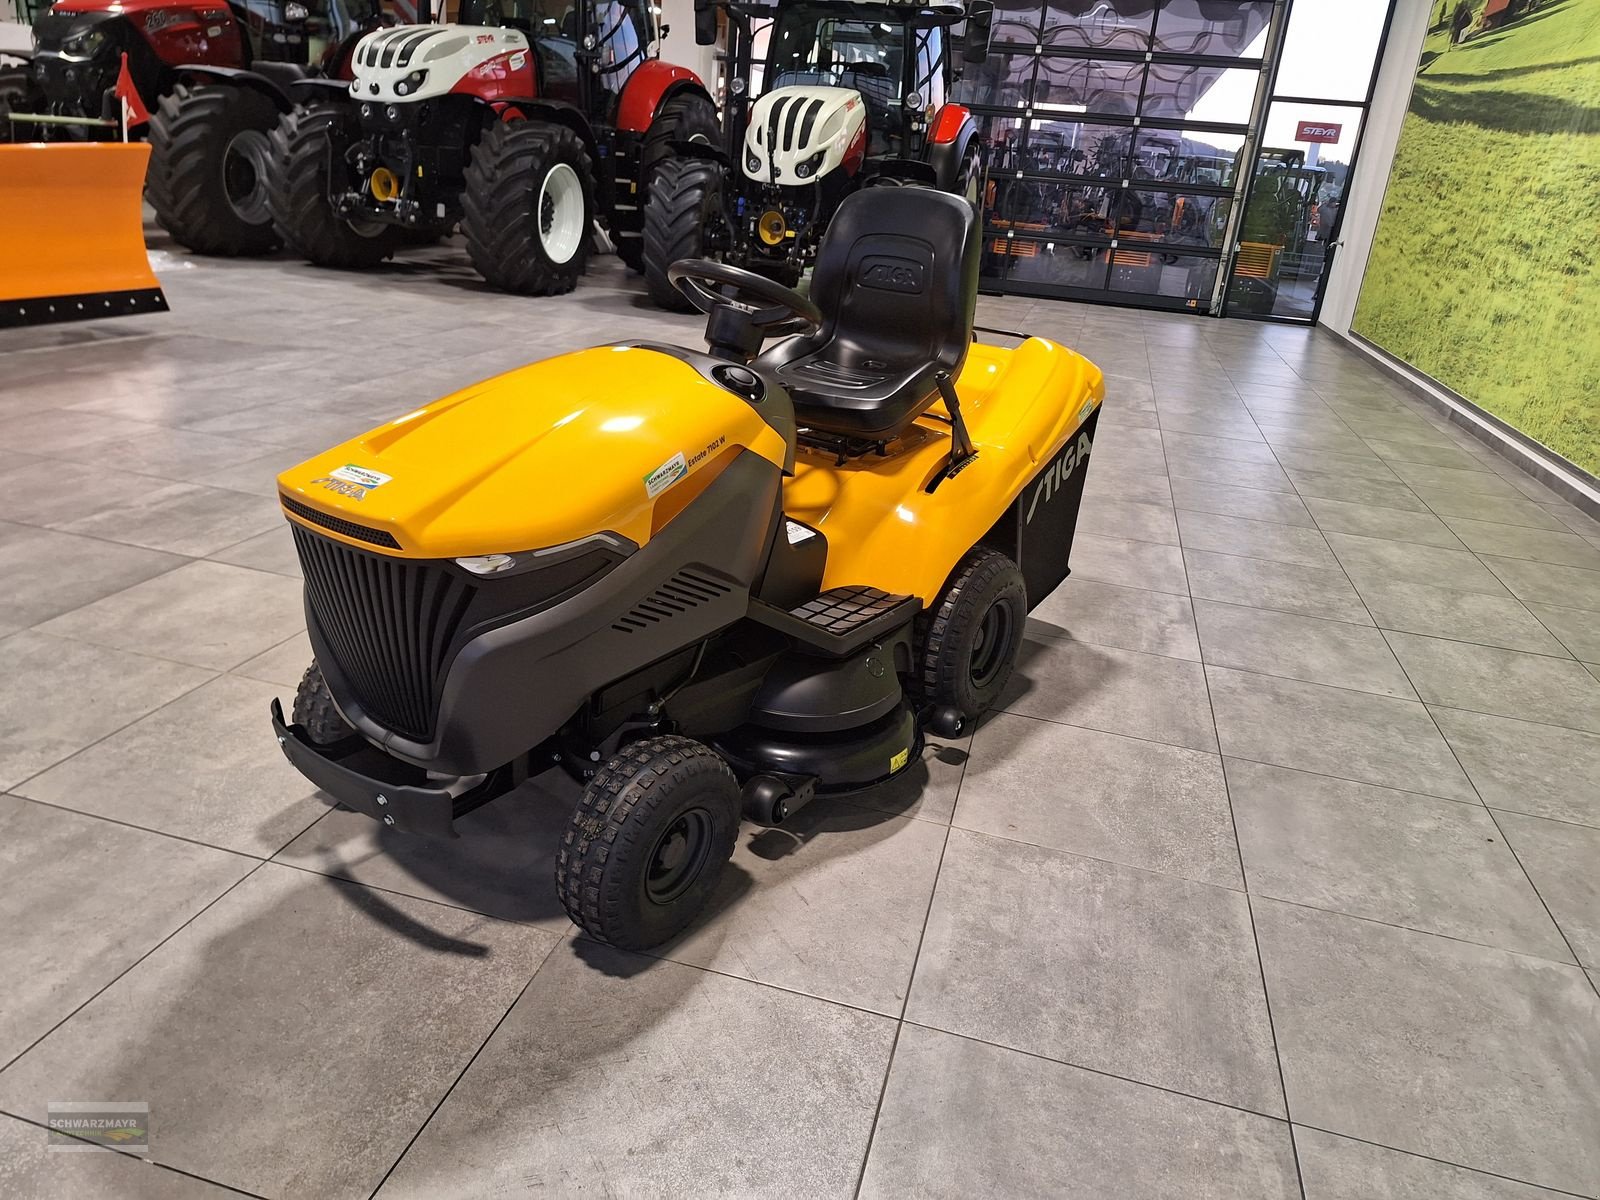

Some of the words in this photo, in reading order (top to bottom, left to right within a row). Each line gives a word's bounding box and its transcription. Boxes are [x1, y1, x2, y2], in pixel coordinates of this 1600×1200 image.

[1302, 126, 1337, 137] STEYR
[688, 451, 707, 467] Estate
[707, 440, 720, 453] 7102
[719, 434, 726, 445] W
[648, 461, 680, 485] SCHWARZMAYR
[1026, 431, 1092, 526] STIGA
[311, 477, 367, 502] STIGA
